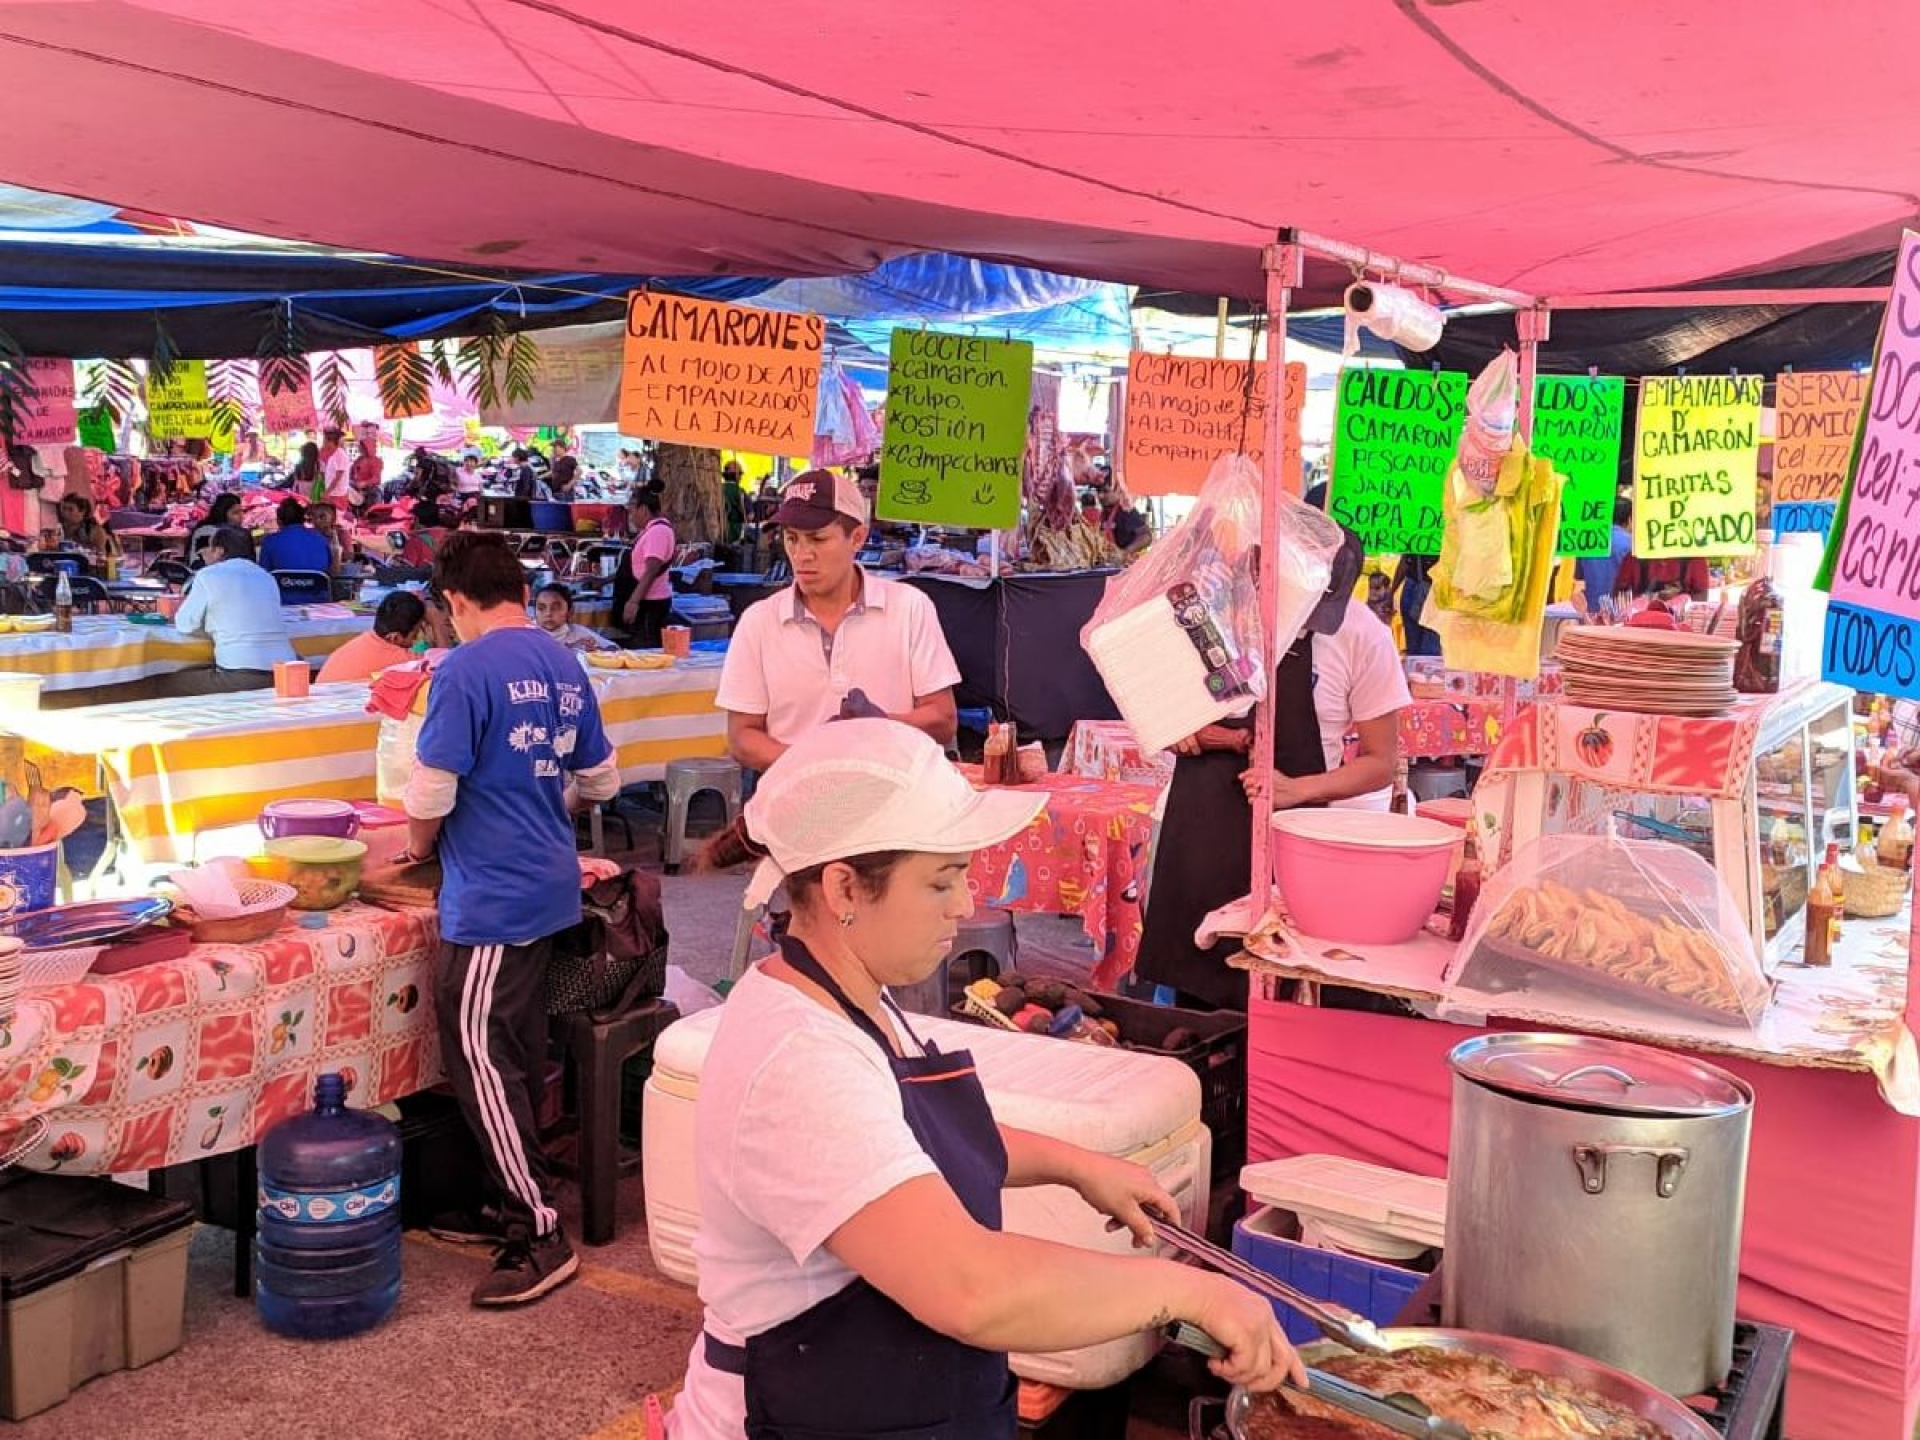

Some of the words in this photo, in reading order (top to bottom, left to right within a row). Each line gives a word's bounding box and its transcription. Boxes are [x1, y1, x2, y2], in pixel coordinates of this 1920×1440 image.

[628, 291, 822, 351] CAMARONES
[640, 354, 667, 377] AL
[681, 357, 740, 385] MOJO
[747, 364, 773, 385] DE
[778, 365, 817, 392] AJO
[648, 384, 811, 418] EMPANIZADOS
[1214, 399, 1236, 415] de
[1536, 381, 1618, 417] LDOS:
[1643, 377, 1762, 407] EMPANADAS
[1782, 374, 1864, 408] SERVI
[1872, 351, 1920, 434] DO
[646, 407, 663, 428] A
[674, 409, 700, 431] LA
[716, 410, 795, 441] DIABLA
[1138, 414, 1151, 428] A
[1155, 416, 1175, 434] la
[1778, 408, 1858, 439] DOMIC
[1353, 448, 1446, 475] PESCADO
[1353, 474, 1412, 500] JAIBA
[1641, 470, 1733, 499] TIRITAS
[1332, 496, 1403, 529] SOPA
[1581, 500, 1607, 522] DE
[1361, 529, 1442, 553] ARISCOS
[1557, 525, 1609, 552] ISCOS
[1646, 511, 1753, 550] PESCADO
[1827, 604, 1915, 687] TODOS
